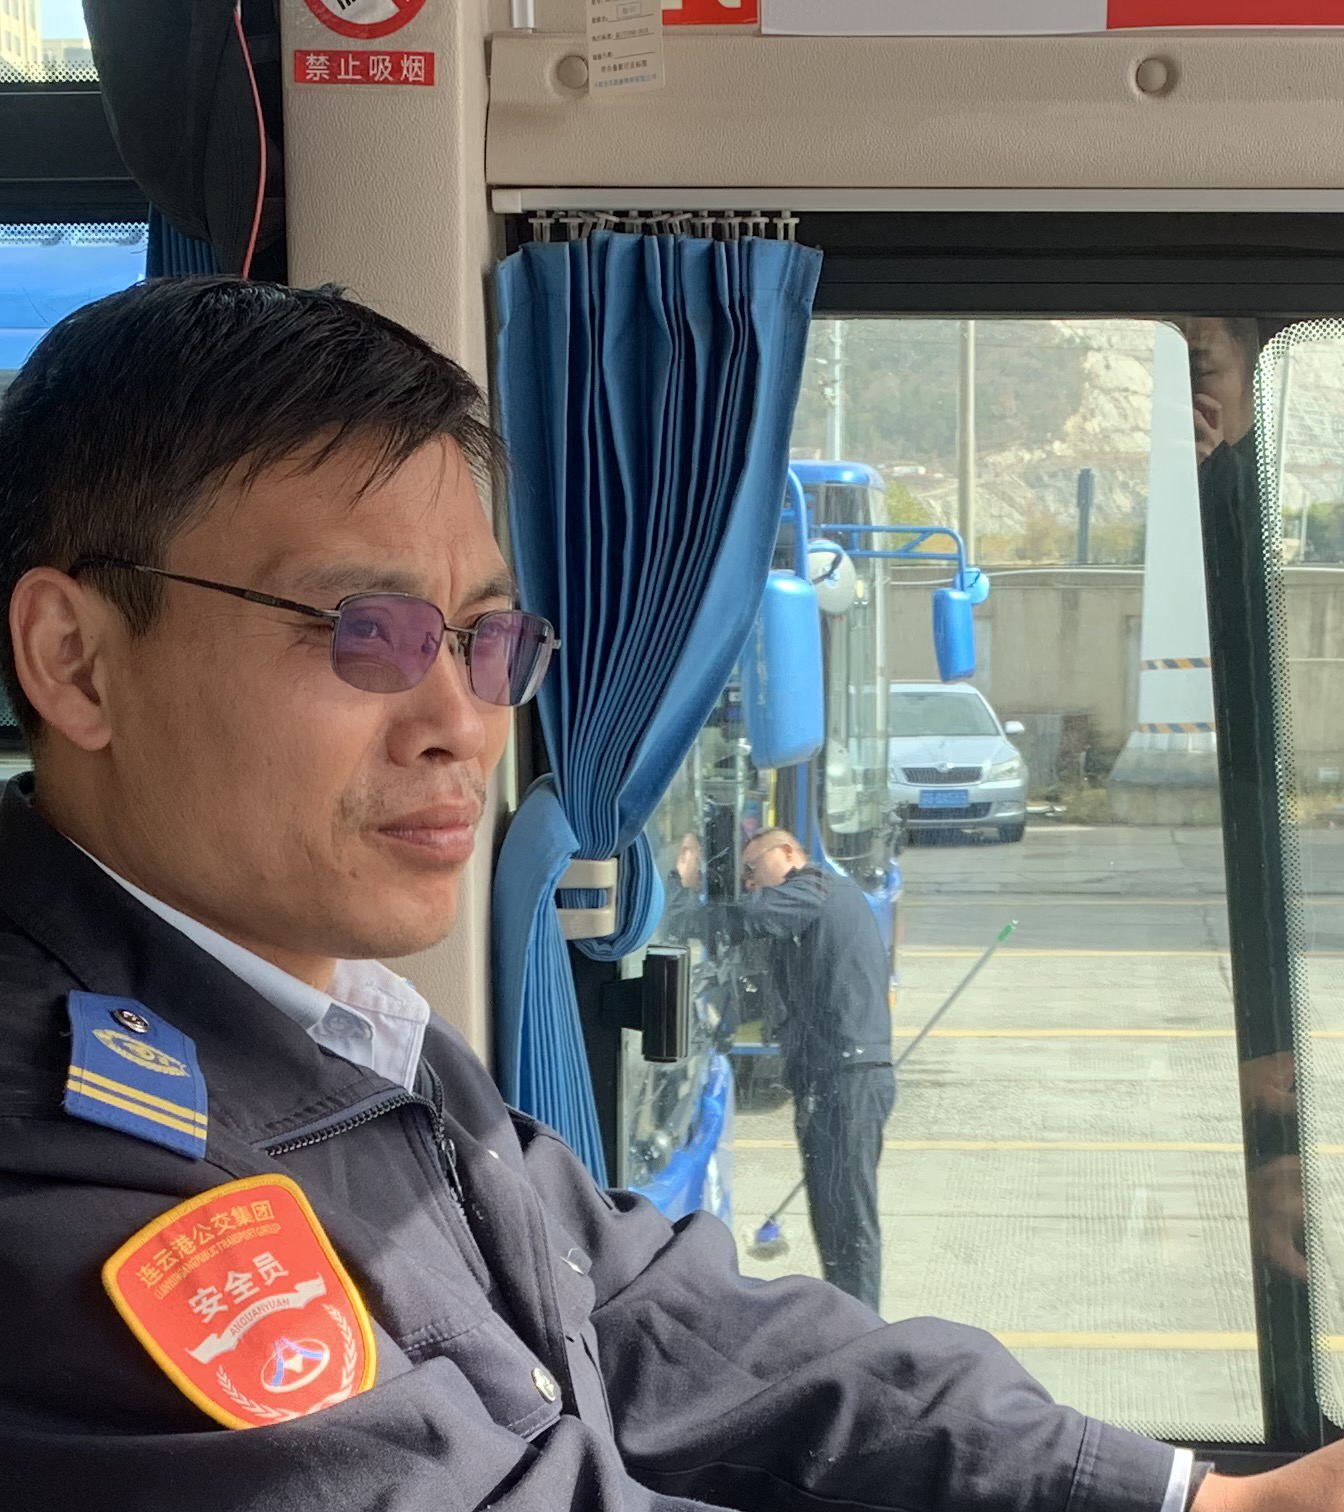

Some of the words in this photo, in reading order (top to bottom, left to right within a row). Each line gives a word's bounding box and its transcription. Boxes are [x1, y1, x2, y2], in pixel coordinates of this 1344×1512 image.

[305, 53, 425, 82] 禁止吸烟
[135, 1199, 275, 1289] 连云港公交集团
[188, 1251, 289, 1324] 安全员
